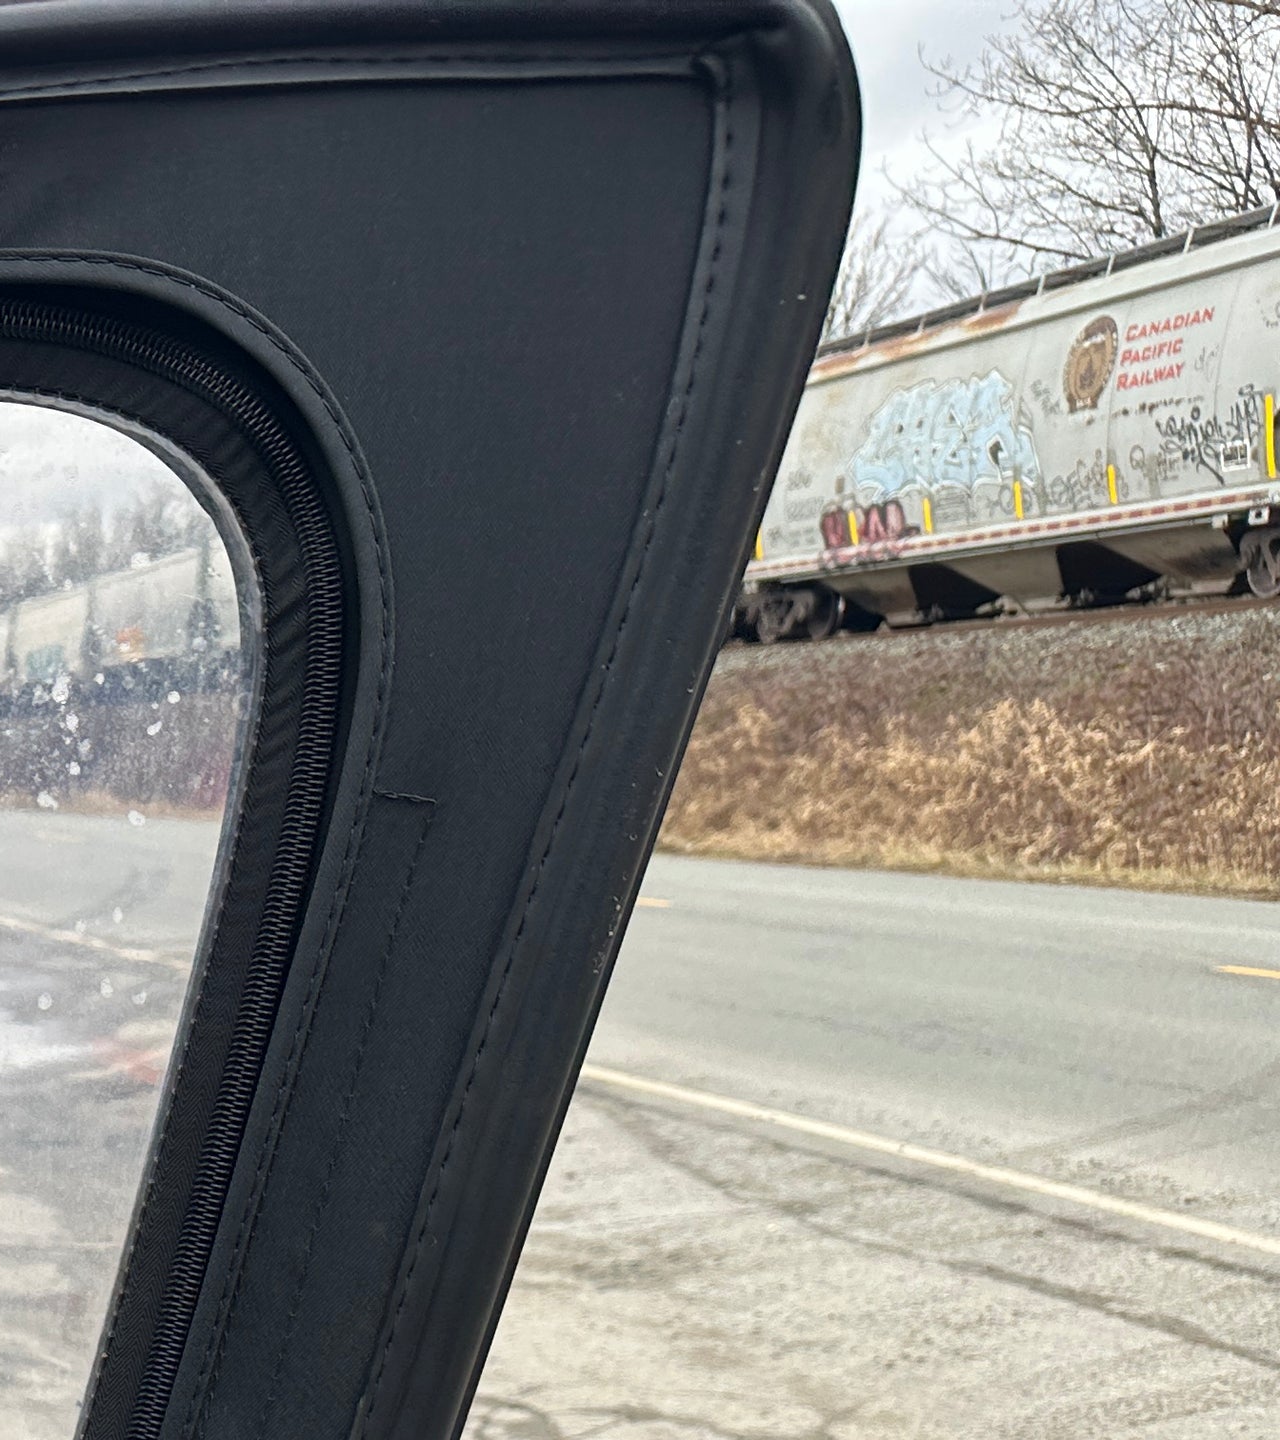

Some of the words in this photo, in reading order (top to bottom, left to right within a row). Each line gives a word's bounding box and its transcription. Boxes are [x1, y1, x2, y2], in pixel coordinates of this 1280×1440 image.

[1125, 306, 1216, 343] CANADIAN
[1119, 338, 1185, 368] PACIFIC
[1116, 361, 1186, 392] RAILWAY
